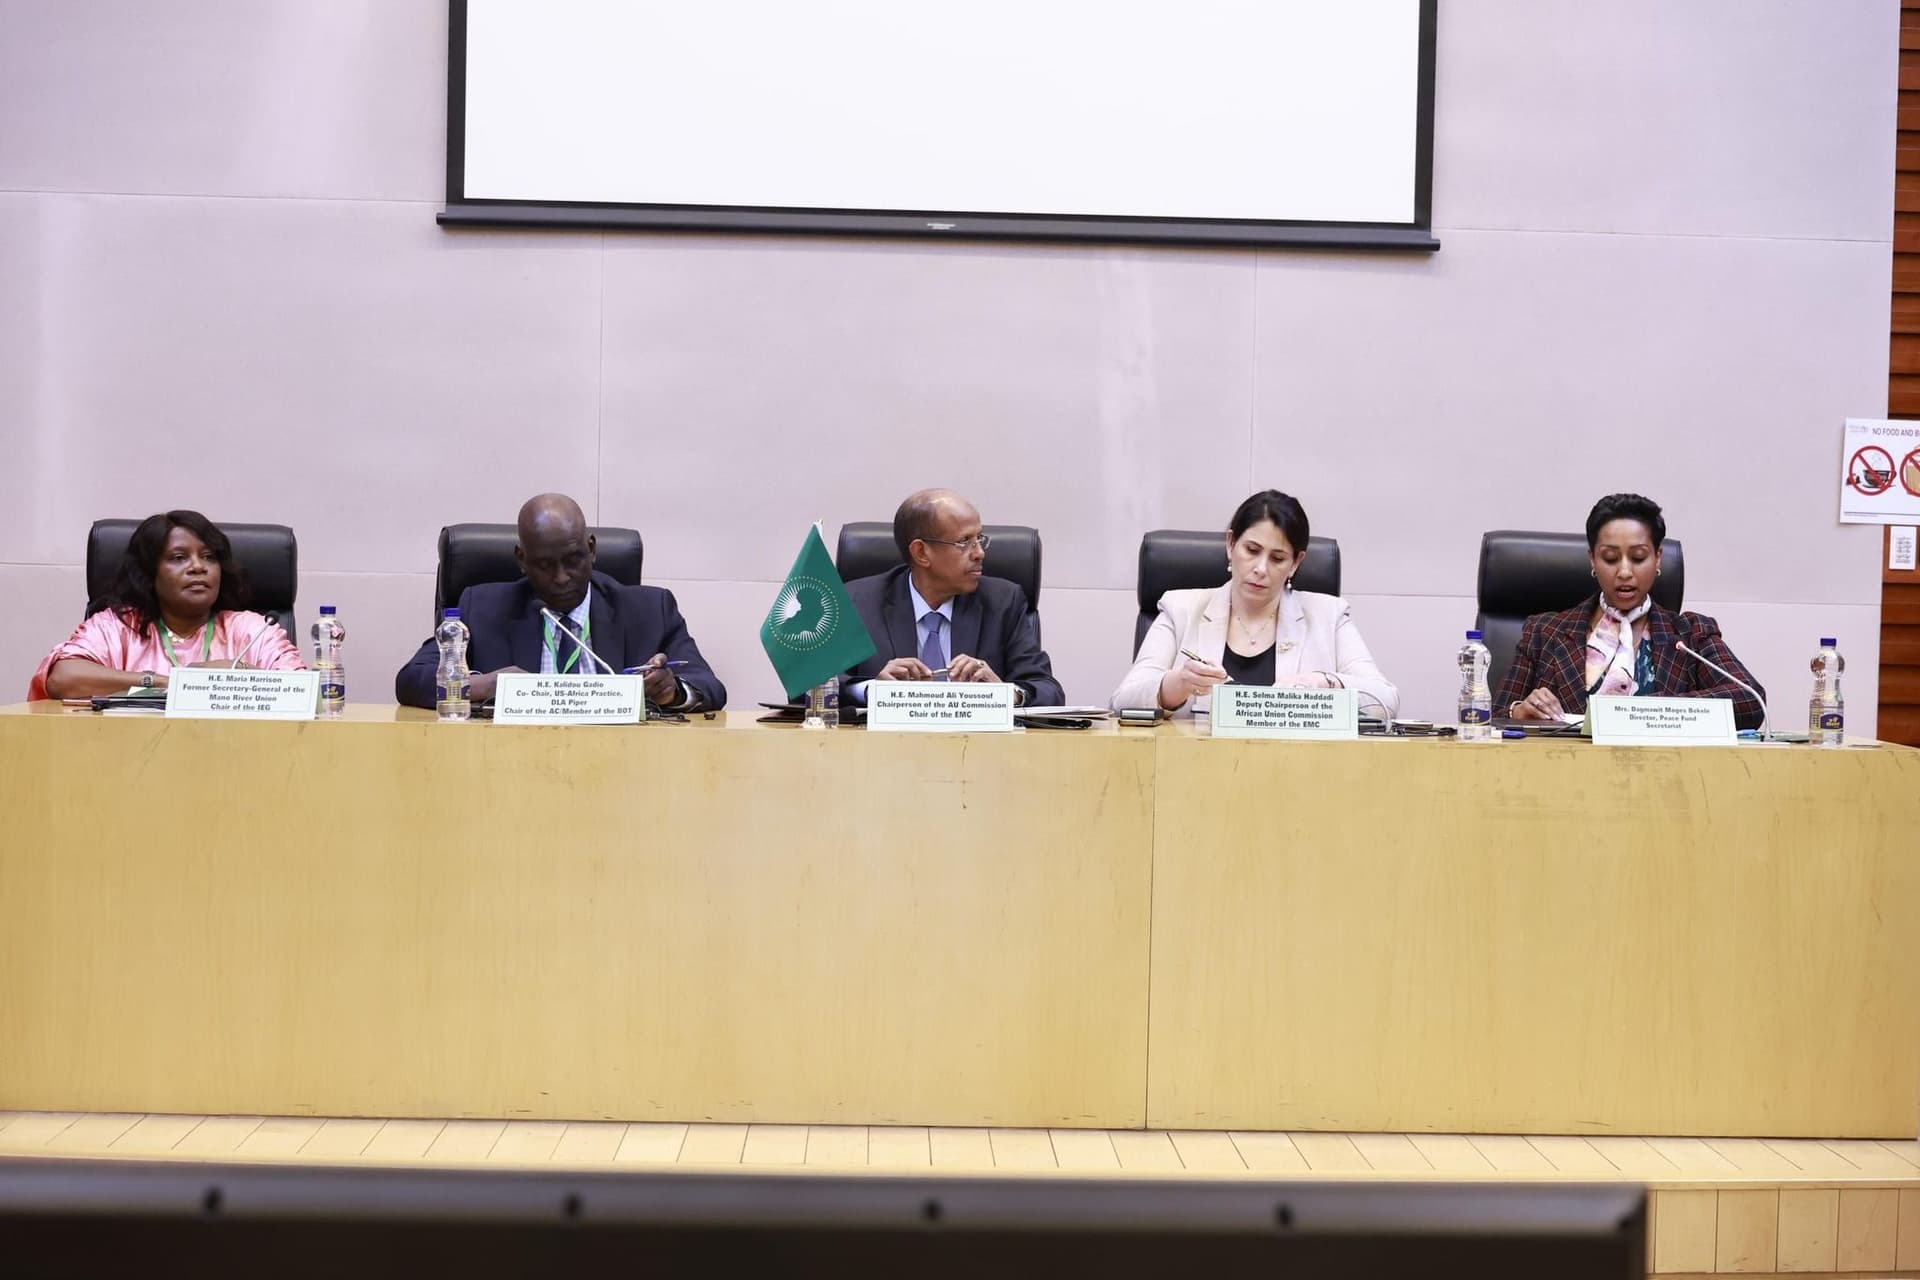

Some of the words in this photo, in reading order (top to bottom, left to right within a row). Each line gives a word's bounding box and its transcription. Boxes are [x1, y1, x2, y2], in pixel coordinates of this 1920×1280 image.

[1883, 428, 1900, 436] FOOD
[1901, 429, 1913, 437] AND
[212, 685, 281, 693] Secretary-General
[1236, 701, 1262, 709] Deputy
[1264, 702, 1309, 710] Chairperson
